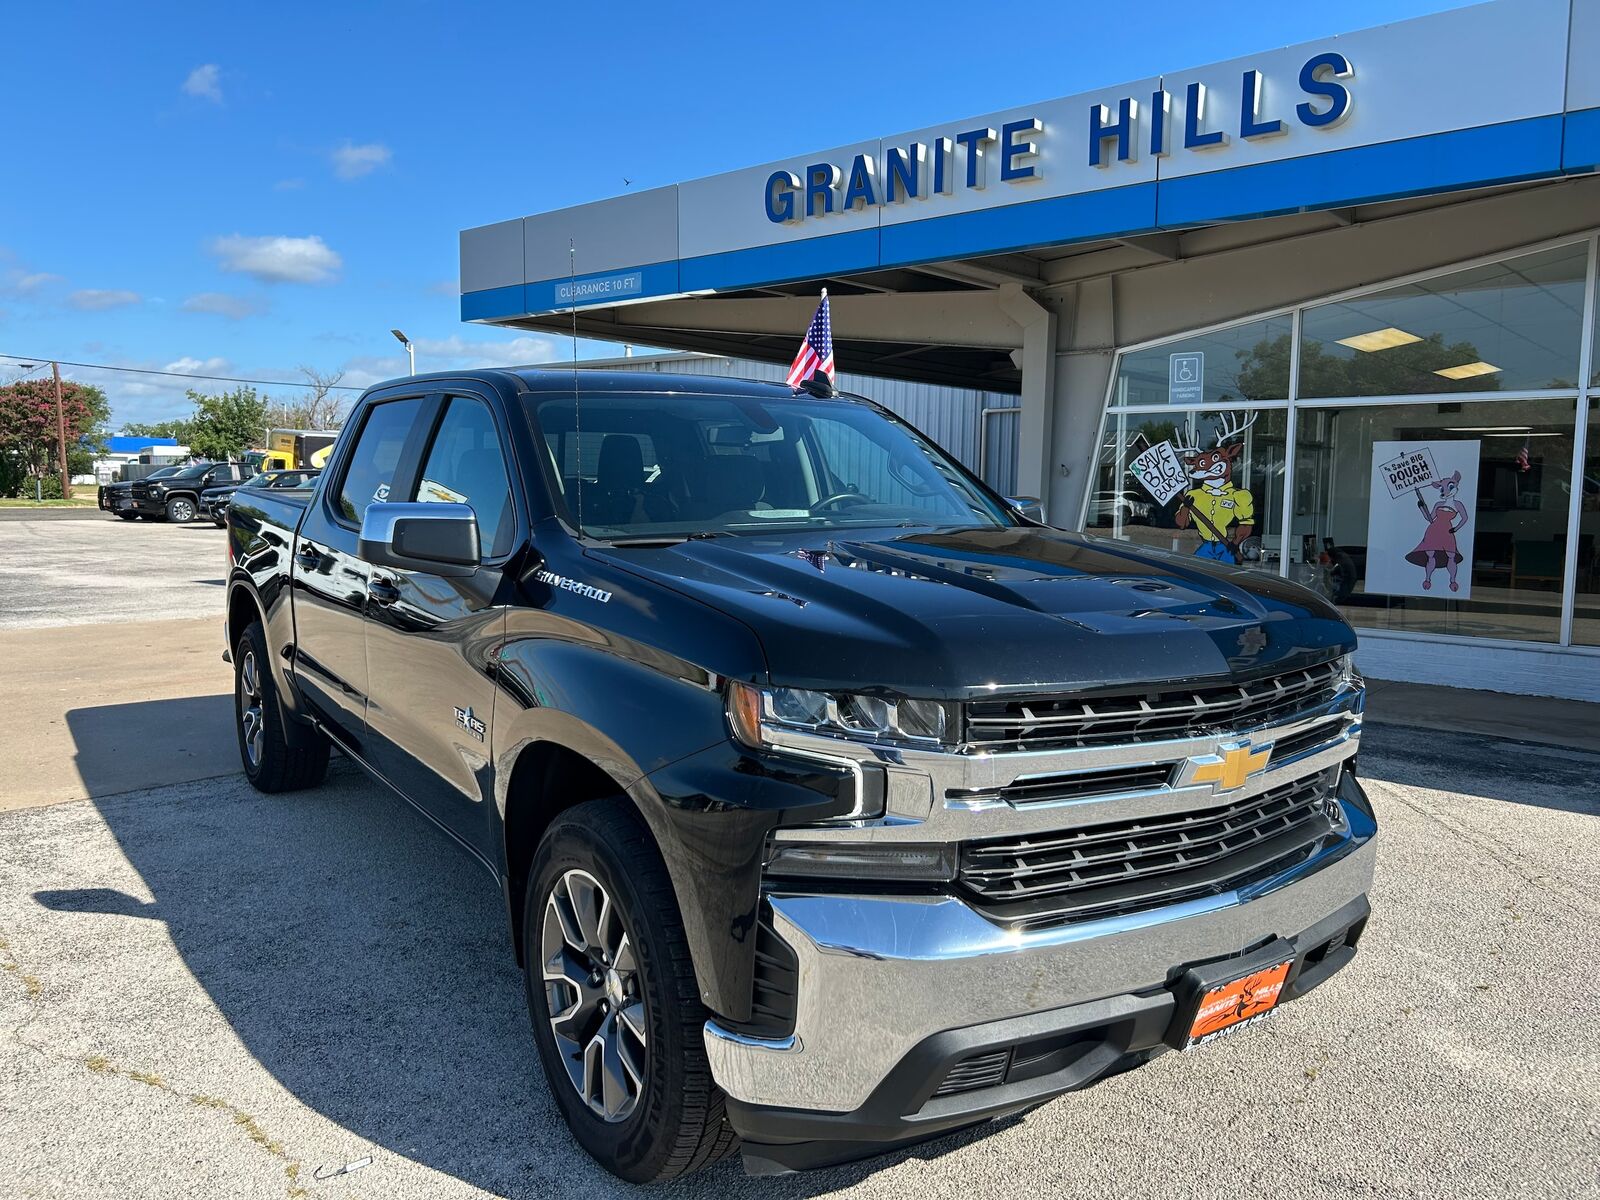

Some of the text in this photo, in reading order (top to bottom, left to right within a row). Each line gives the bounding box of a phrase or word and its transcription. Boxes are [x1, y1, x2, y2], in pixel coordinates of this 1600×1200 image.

[764, 52, 1355, 224] GRANITE HILLS
[560, 277, 635, 298] CLEARANCE 10 FT
[1137, 443, 1171, 472] SAVE
[1391, 453, 1424, 471] Save BIG
[1143, 460, 1176, 488] BIG
[1154, 470, 1187, 501] BUCKS
[1389, 460, 1429, 485] DOUGH
[1403, 470, 1433, 488] LLANO!
[534, 569, 613, 603] SILVERADO
[453, 706, 486, 733] TEXAS
[1199, 1020, 1250, 1045] GRANITE
